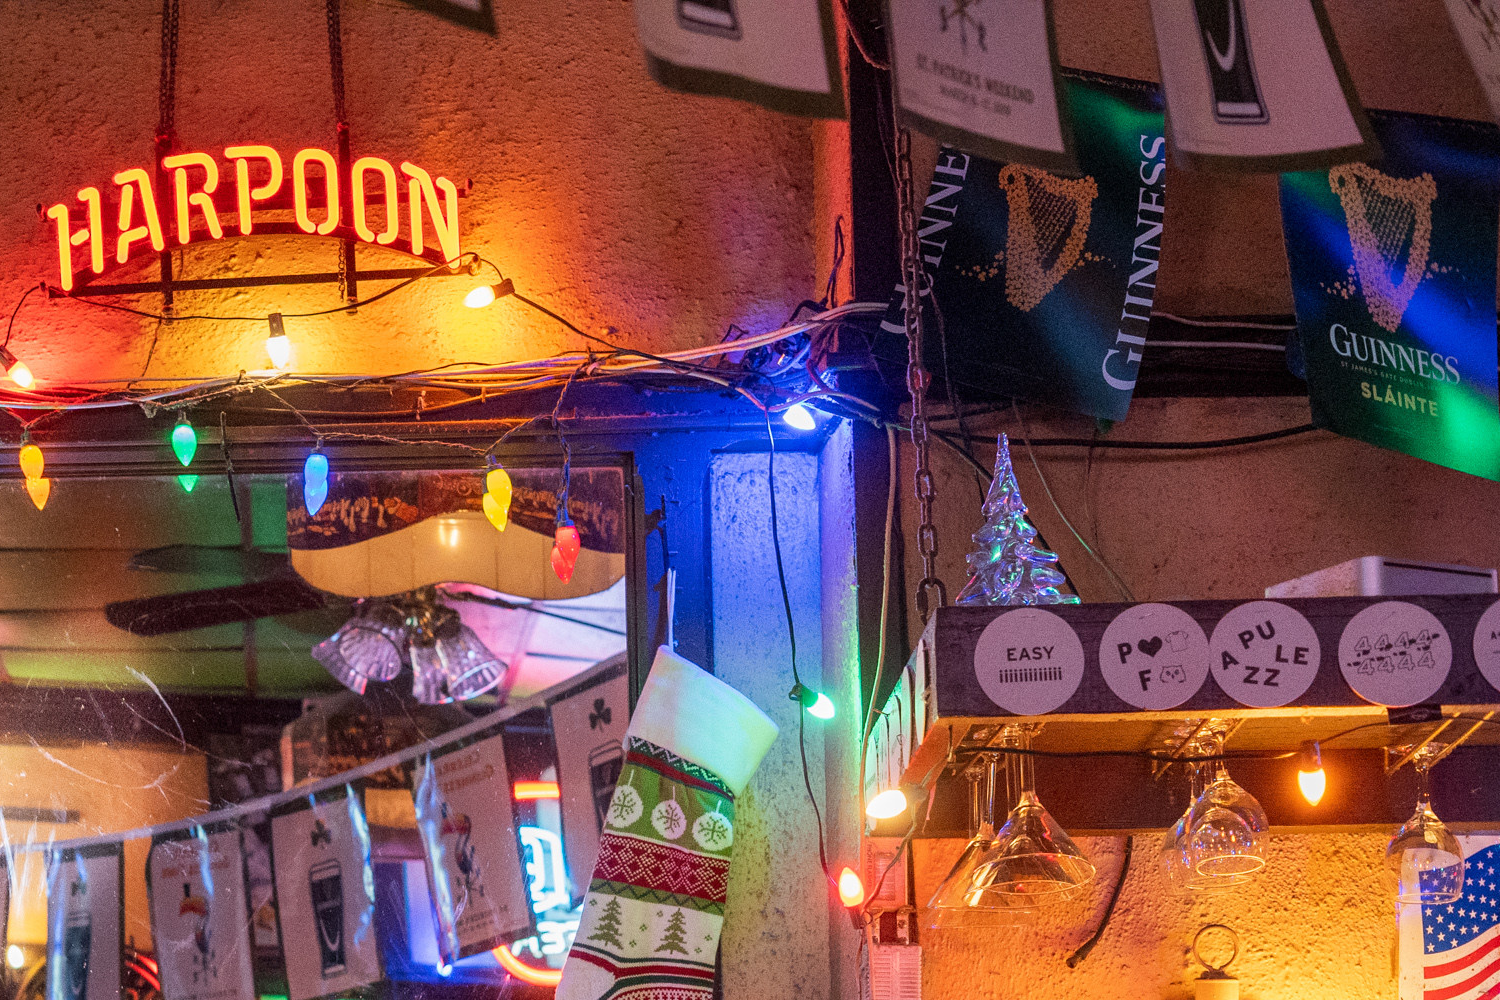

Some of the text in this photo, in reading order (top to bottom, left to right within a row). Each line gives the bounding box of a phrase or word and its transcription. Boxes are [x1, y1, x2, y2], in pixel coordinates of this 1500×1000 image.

[48, 145, 461, 291] HARPOON
[1102, 134, 1166, 391] GUINNESS
[1329, 323, 1461, 385] GUINNESS
[1360, 382, 1438, 417] SLÁINTE
[1007, 646, 1054, 661] EASY
[1117, 641, 1133, 664] P
[1139, 668, 1152, 692] F
